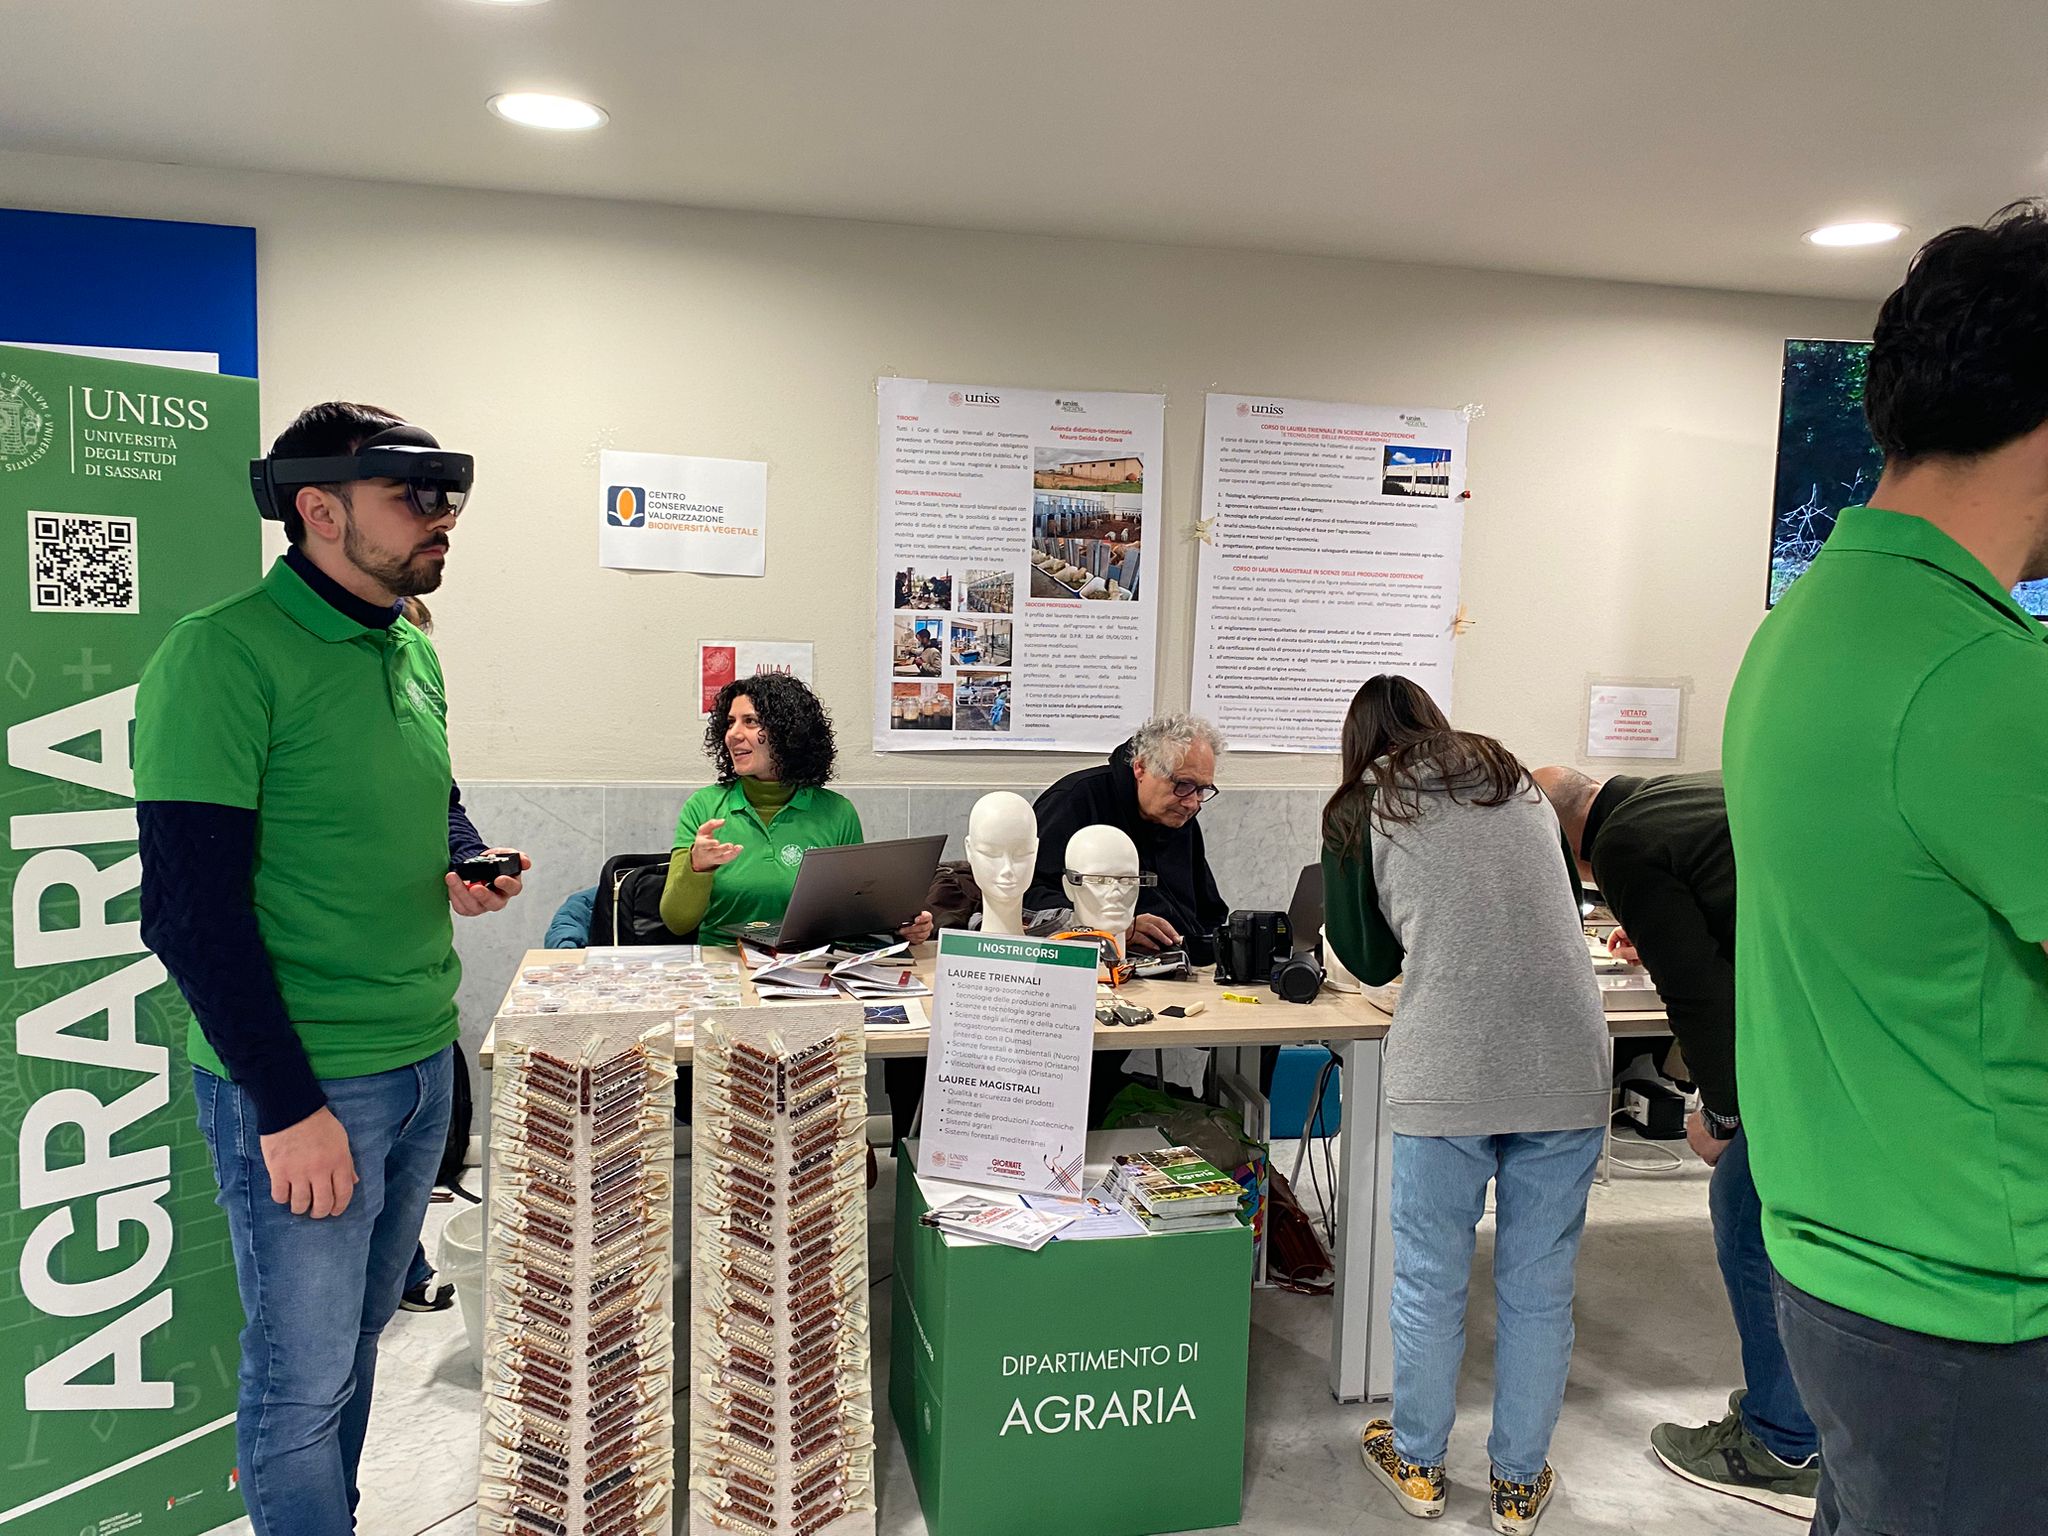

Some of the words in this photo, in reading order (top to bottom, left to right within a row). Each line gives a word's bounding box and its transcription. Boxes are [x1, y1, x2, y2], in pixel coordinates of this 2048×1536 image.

[965, 392, 1000, 404] uniss
[82, 387, 208, 430] UNISS
[1250, 404, 1284, 415] uniss
[84, 429, 177, 449] UNIVERSITÀ
[85, 447, 129, 461] DEGLI
[133, 451, 176, 466] STUDI
[86, 464, 101, 476] DI
[105, 465, 161, 481] SASSARI
[648, 491, 686, 500] CENTRO
[648, 501, 723, 513] CONSERVAZIONE
[648, 512, 724, 523] VALORIZZAZIONE
[648, 522, 710, 532] BIODIVERSITÀ
[712, 526, 758, 536] VEGETALE
[978, 943, 981, 951] I
[983, 943, 1023, 955] NOSTRI
[1025, 947, 1058, 959] CORSI
[948, 969, 986, 980] LAUREE
[989, 973, 1041, 985] TRIENNALI
[957, 982, 983, 991] Scienze
[984, 986, 1044, 997] agro-zootecniche
[956, 992, 992, 1002] tecnologie
[1011, 999, 1049, 1007] produzioni
[955, 1001, 981, 1010] Scienze
[988, 1006, 1025, 1015] tecnologie
[954, 1011, 980, 1020] Scienze
[982, 1014, 999, 1023] degli
[1000, 1016, 1029, 1025] alimenti
[954, 1022, 1013, 1033] enogastronomica
[1014, 1028, 1062, 1039] mediterranea
[7, 683, 175, 1411] AGRARIA
[952, 1040, 978, 1049] Scienze
[979, 1043, 1006, 1052] forestali
[1014, 1048, 1051, 1058] ambientali
[1053, 1052, 1080, 1062] (Nuoro)
[951, 1050, 988, 1060] Orticoltura
[995, 1055, 1043, 1067] Florovivaismo
[1044, 1061, 1079, 1072] (Oristano)
[950, 1060, 985, 1070] Viticoltura
[997, 1067, 1027, 1075] enologia
[1028, 1069, 1063, 1080] (Oristano)
[938, 1074, 976, 1086] LAUREE
[980, 1080, 1040, 1094] MAGISTRALI
[947, 1098, 982, 1108] alimentari
[948, 1088, 972, 1097] Qualità
[980, 1093, 1011, 1102] sicurezza
[1025, 1099, 1054, 1107] prodotti
[946, 1108, 972, 1117] Scienze
[992, 1115, 1030, 1124] produzioni
[1030, 1120, 1074, 1131] zootecniche
[946, 1118, 971, 1127] Sistemi
[944, 1128, 970, 1136] Sistemi
[971, 1131, 998, 1140] forestali
[1000, 1137, 1045, 1147] mediterranei
[992, 1158, 1022, 1170] GIORNATE
[1003, 1345, 1170, 1376] DIPARTIMENTO
[1179, 1342, 1198, 1362] DI
[1000, 1384, 1196, 1436] AGRARIA
